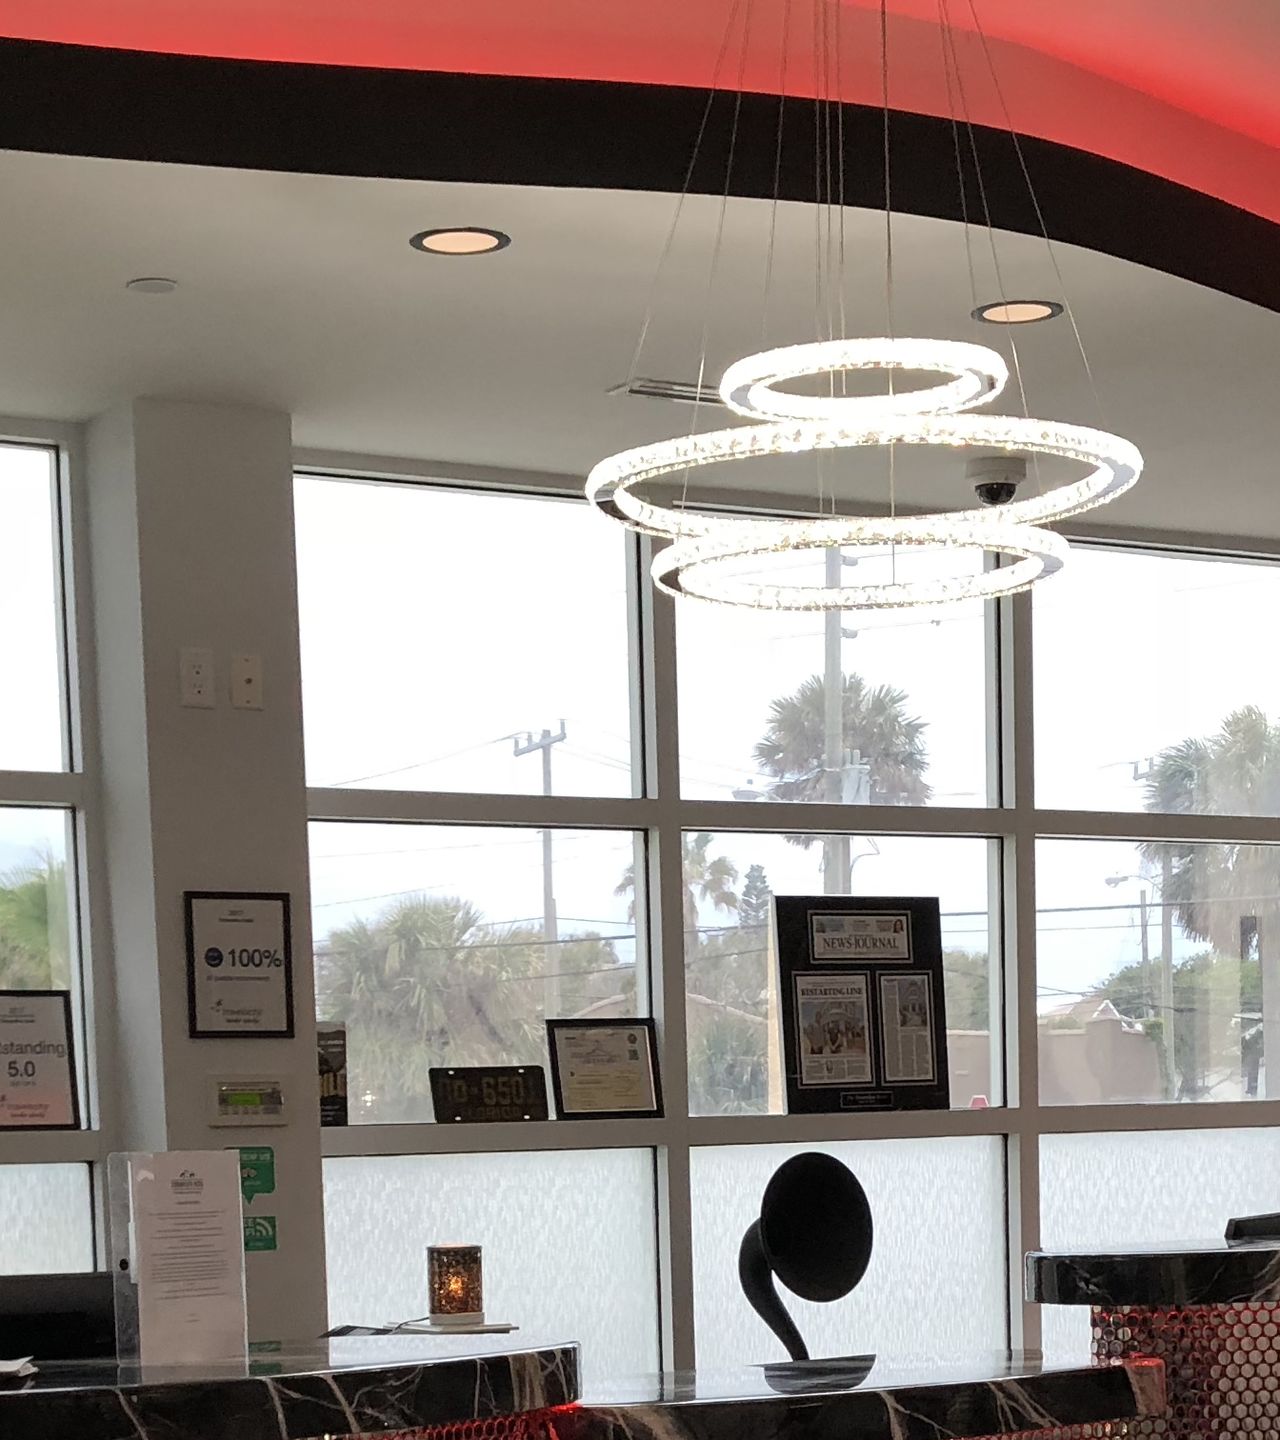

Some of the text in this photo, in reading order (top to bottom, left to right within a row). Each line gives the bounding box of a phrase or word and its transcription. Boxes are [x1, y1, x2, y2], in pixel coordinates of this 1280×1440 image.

[228, 948, 282, 968] 100%
[846, 987, 863, 995] LINE
[7, 1060, 36, 1077] 5.0
